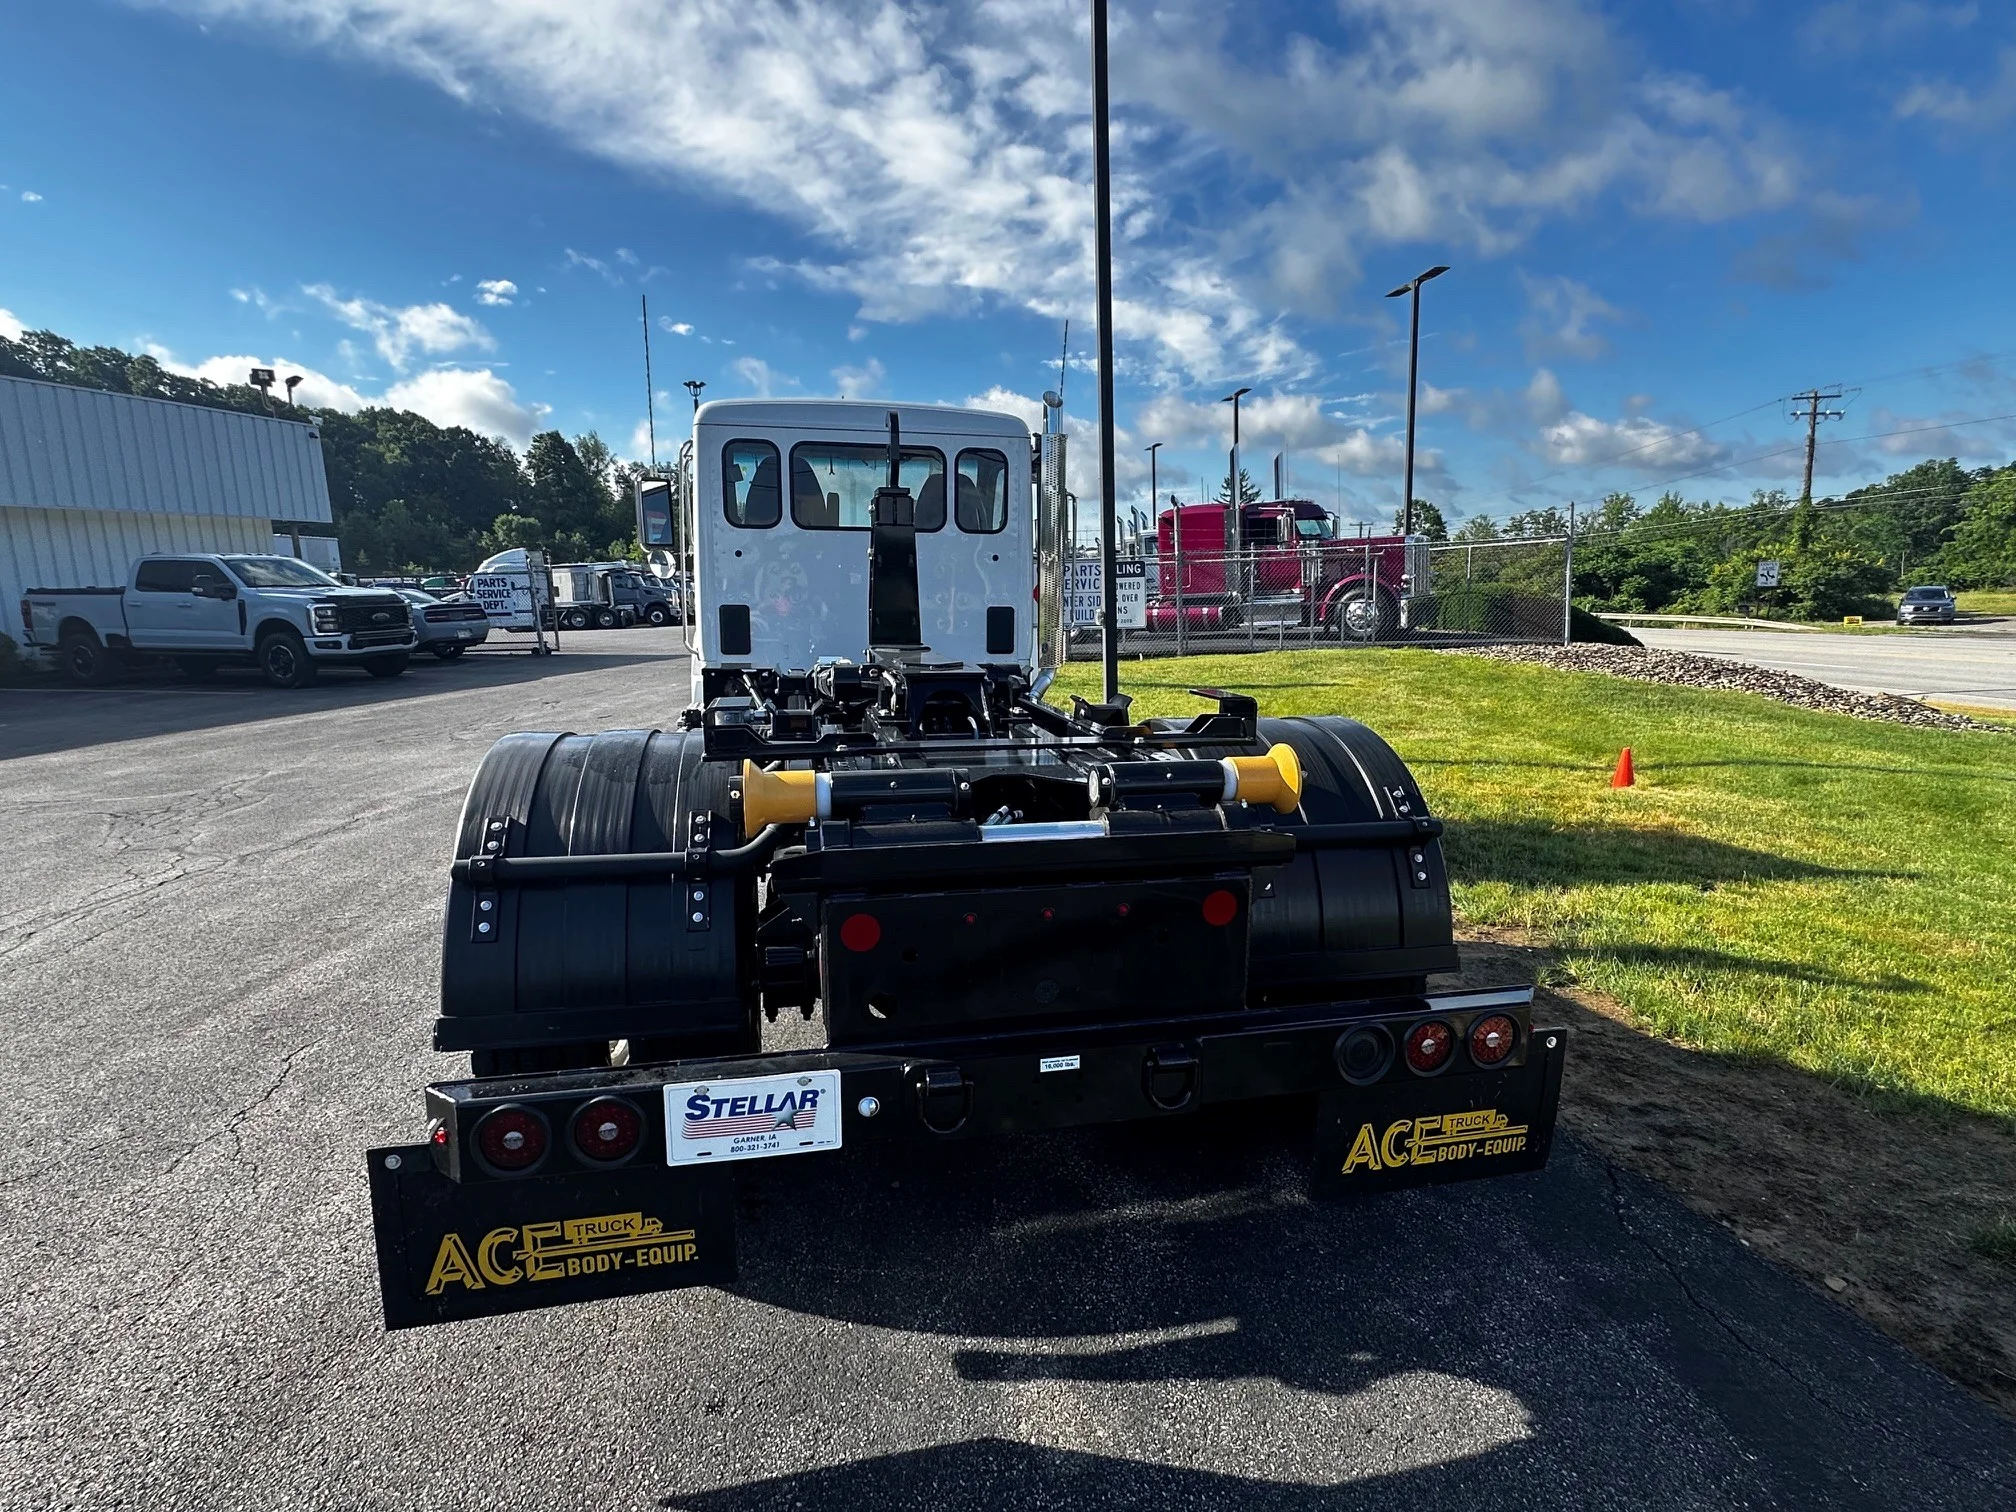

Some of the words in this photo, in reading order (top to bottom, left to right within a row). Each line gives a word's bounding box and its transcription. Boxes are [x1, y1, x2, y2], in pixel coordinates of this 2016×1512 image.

[1116, 564, 1141, 575] LING
[477, 578, 507, 588] PARTS
[1064, 578, 1100, 590] ERVIC
[477, 589, 511, 599] SERVICE
[1121, 593, 1139, 603] OVER
[483, 600, 508, 610] DEPT.
[1087, 595, 1102, 607] SID
[685, 1089, 819, 1121] STELLAR
[768, 1133, 777, 1141] IA
[730, 1141, 780, 1153] 800-321-3741
[1341, 1115, 1442, 1174] ACE
[1448, 1115, 1490, 1129] TRUCK
[1437, 1136, 1527, 1162] BODY-EQUIP.
[425, 1221, 566, 1295] ACE
[573, 1217, 636, 1237] TRUCK
[567, 1243, 699, 1276] BODY-EQUIP.
